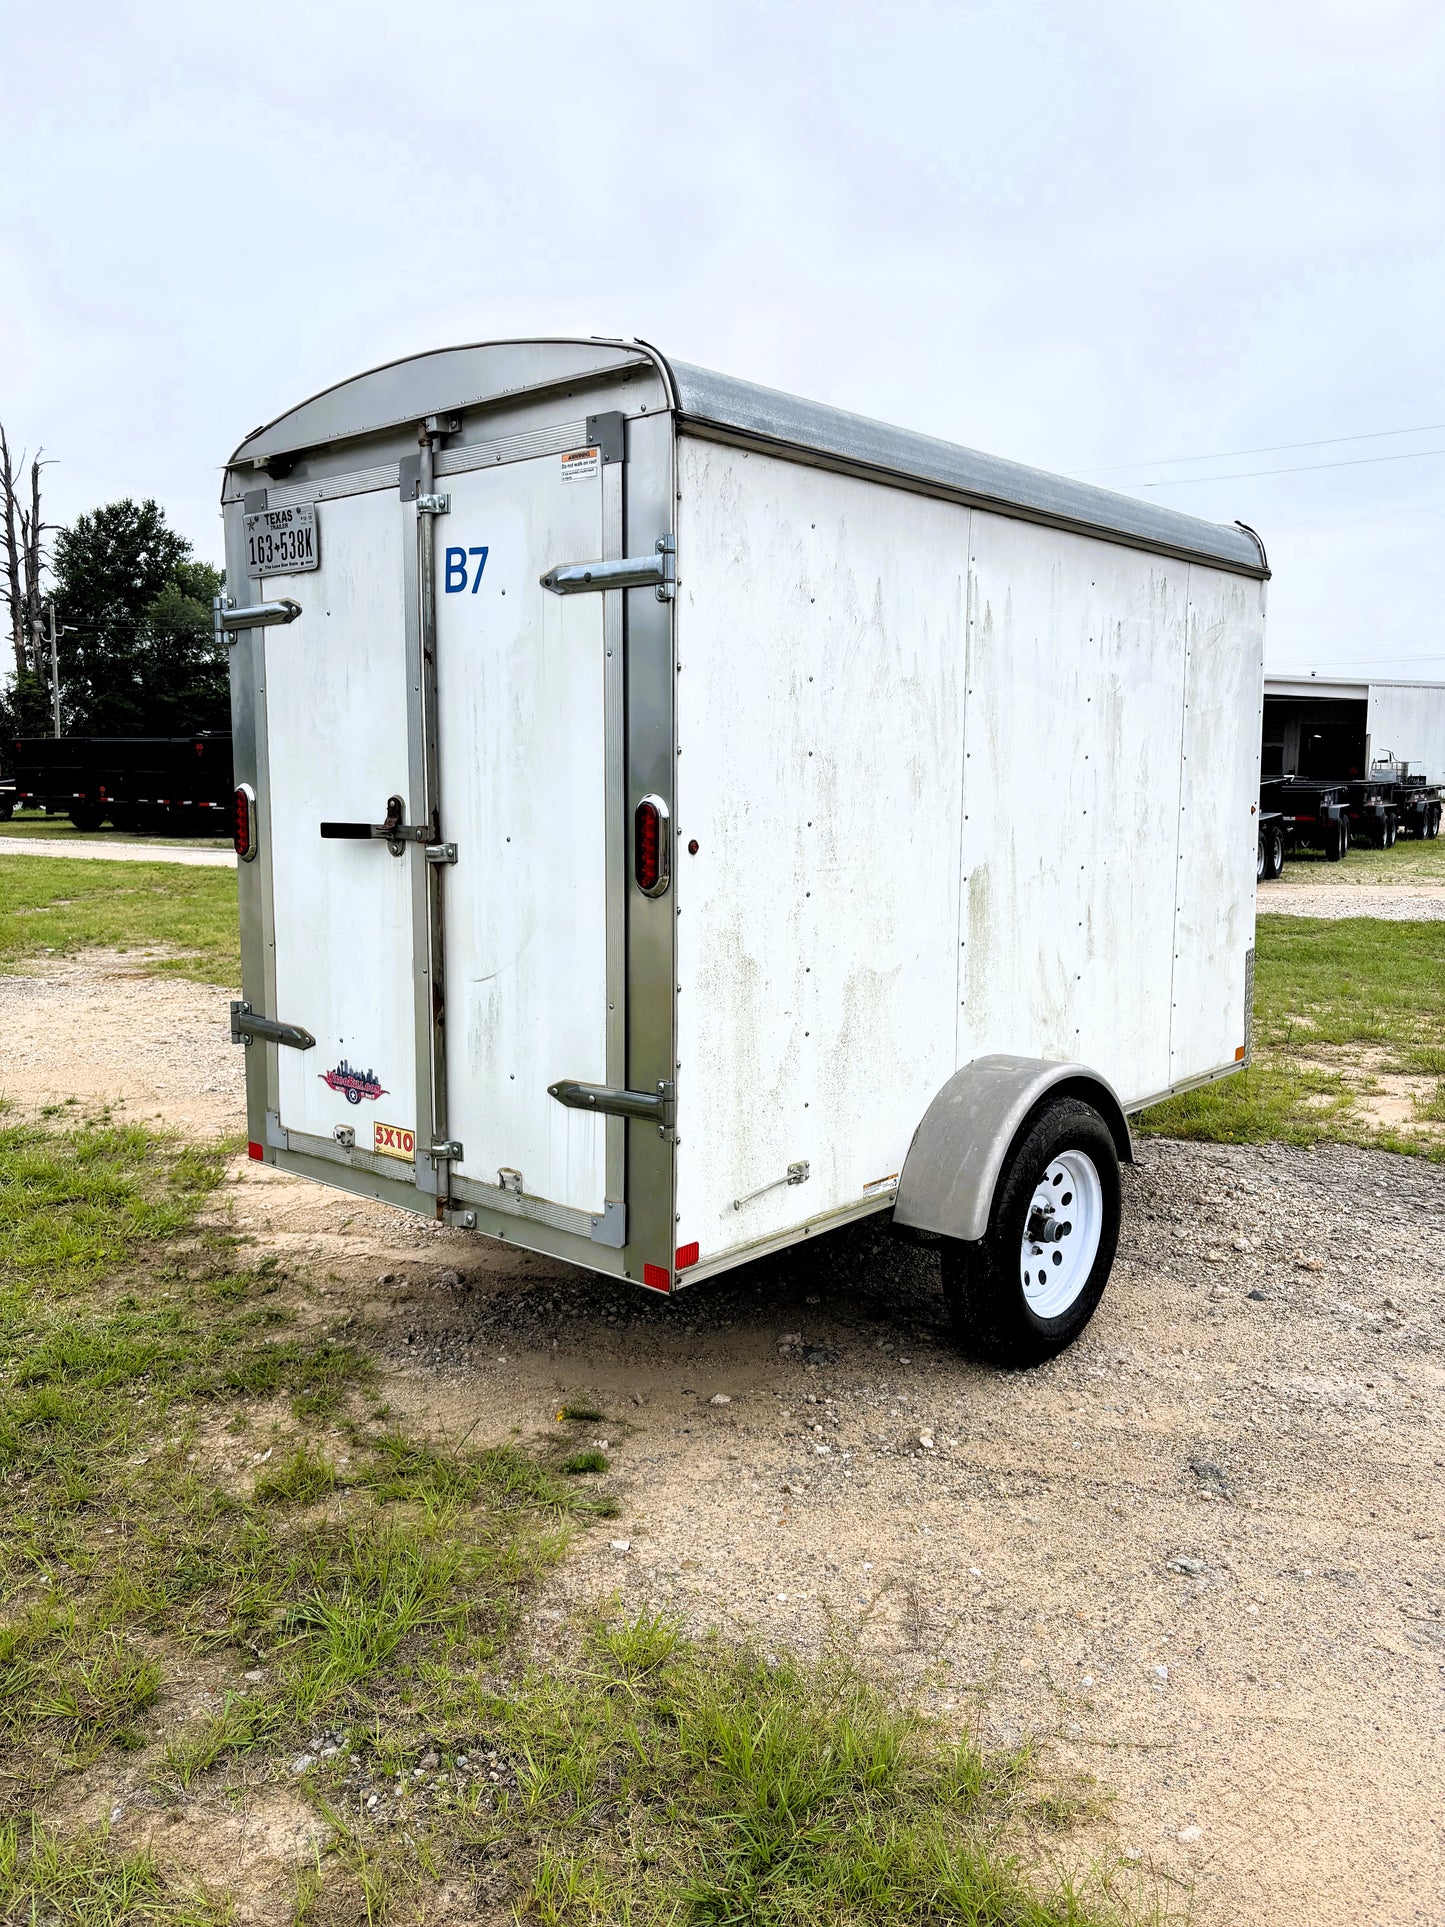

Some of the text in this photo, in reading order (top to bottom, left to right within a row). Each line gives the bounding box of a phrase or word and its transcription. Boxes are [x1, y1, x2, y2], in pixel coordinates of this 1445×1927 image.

[264, 510, 293, 525] TEXAS
[270, 523, 289, 531] TRAILER
[445, 546, 489, 594] B7
[375, 1125, 414, 1153] 5X10
